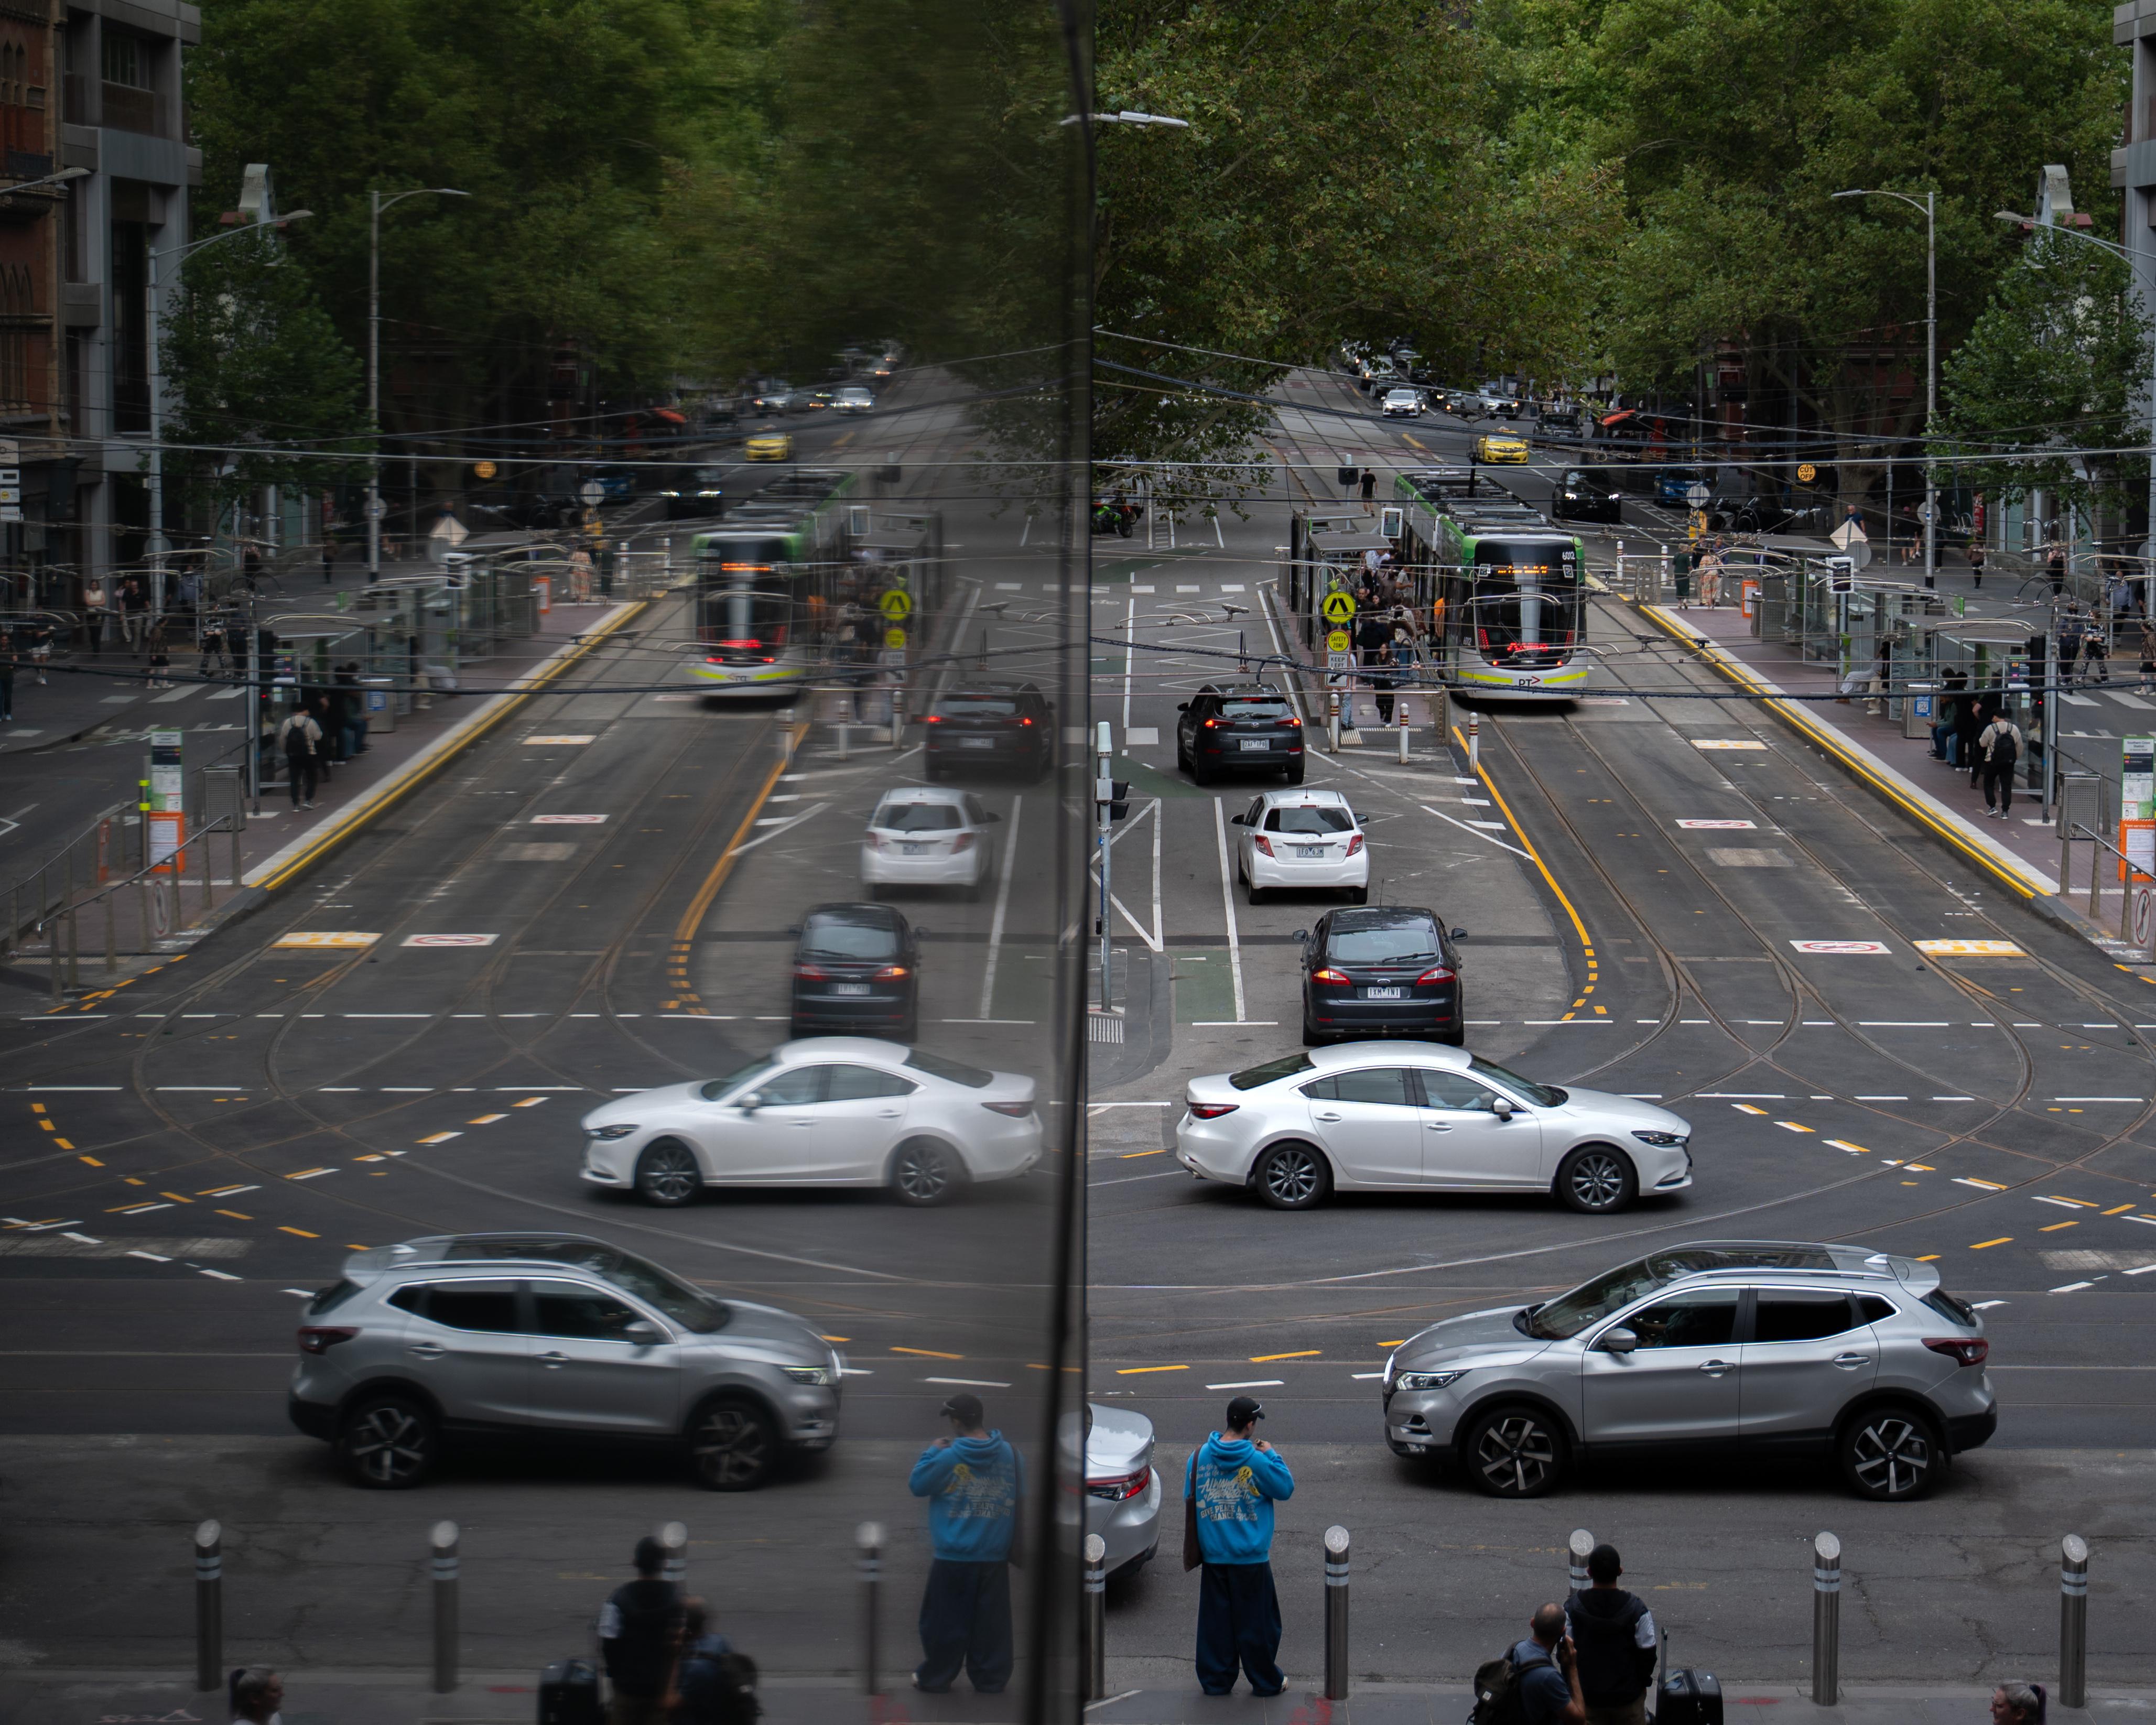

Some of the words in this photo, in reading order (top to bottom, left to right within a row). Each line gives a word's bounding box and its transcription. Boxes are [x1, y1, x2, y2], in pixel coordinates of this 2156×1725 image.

[1562, 551, 1575, 560] 6012
[1200, 1507, 1214, 1518] GIVE
[1215, 1504, 1236, 1513] PEACE
[1210, 1512, 1235, 1521] CHANCE
